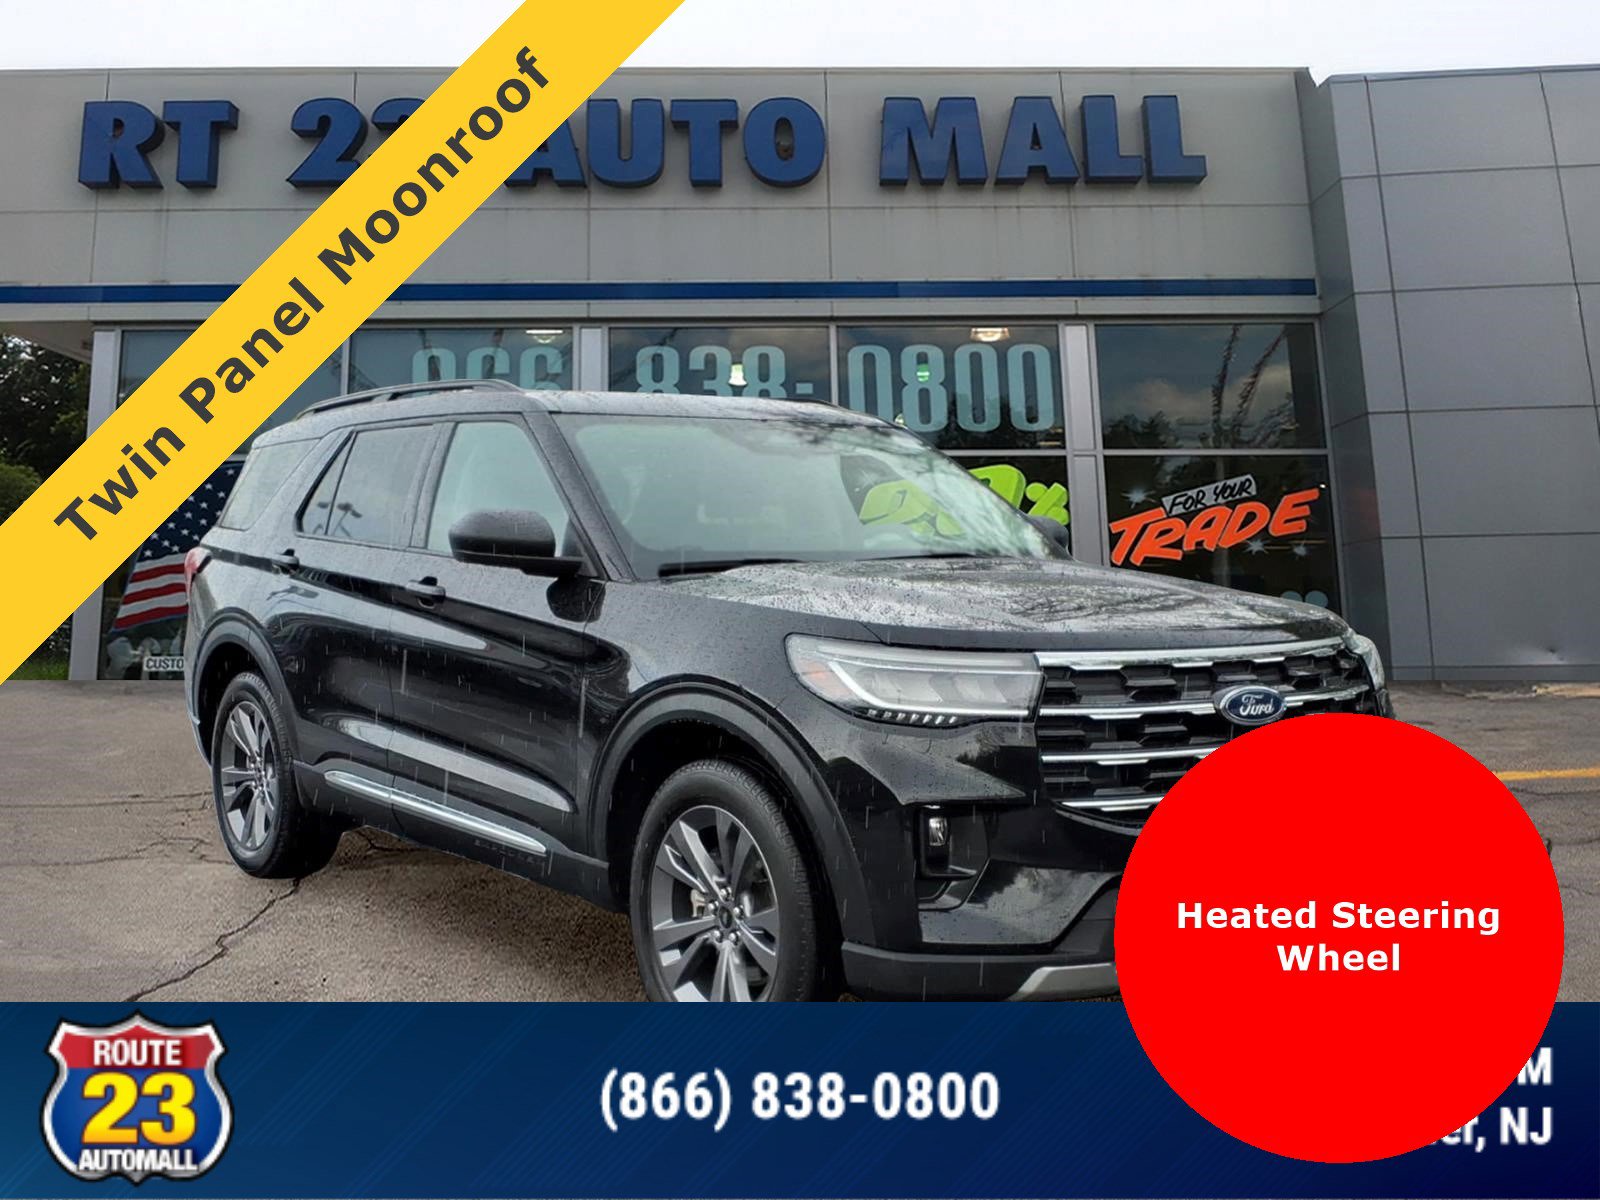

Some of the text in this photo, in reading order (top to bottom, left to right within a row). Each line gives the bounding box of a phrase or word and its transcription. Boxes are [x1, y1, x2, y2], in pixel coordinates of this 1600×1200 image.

[78, 100, 238, 189] RT
[879, 94, 1207, 187] MALL
[848, 343, 1055, 432] 0800
[1109, 487, 1319, 566] TRADE
[1169, 478, 1252, 514] FOR YOUR
[1239, 694, 1275, 717] Ford
